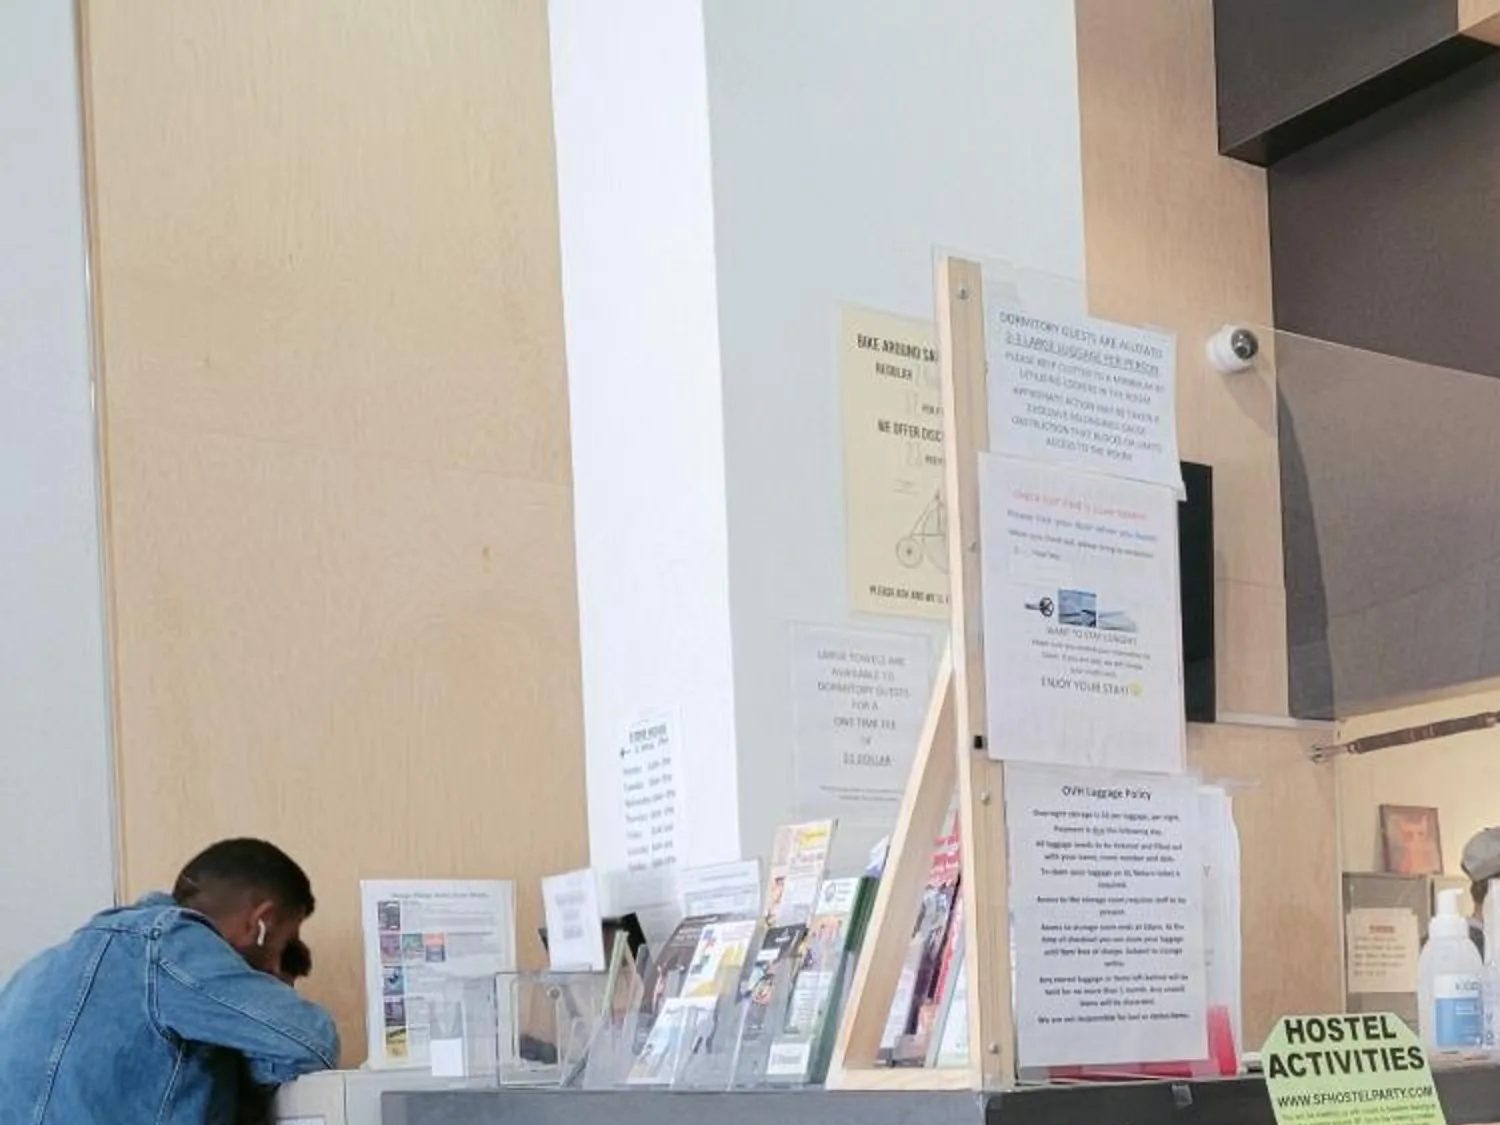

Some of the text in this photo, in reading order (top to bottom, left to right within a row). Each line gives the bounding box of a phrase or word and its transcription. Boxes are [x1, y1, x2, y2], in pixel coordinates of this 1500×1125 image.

[1061, 326, 1097, 345] GUESTS
[1086, 787, 1125, 800] Luggage
[1283, 1015, 1397, 1045] HOSTEL
[1268, 1045, 1426, 1080] ACTIVITIES
